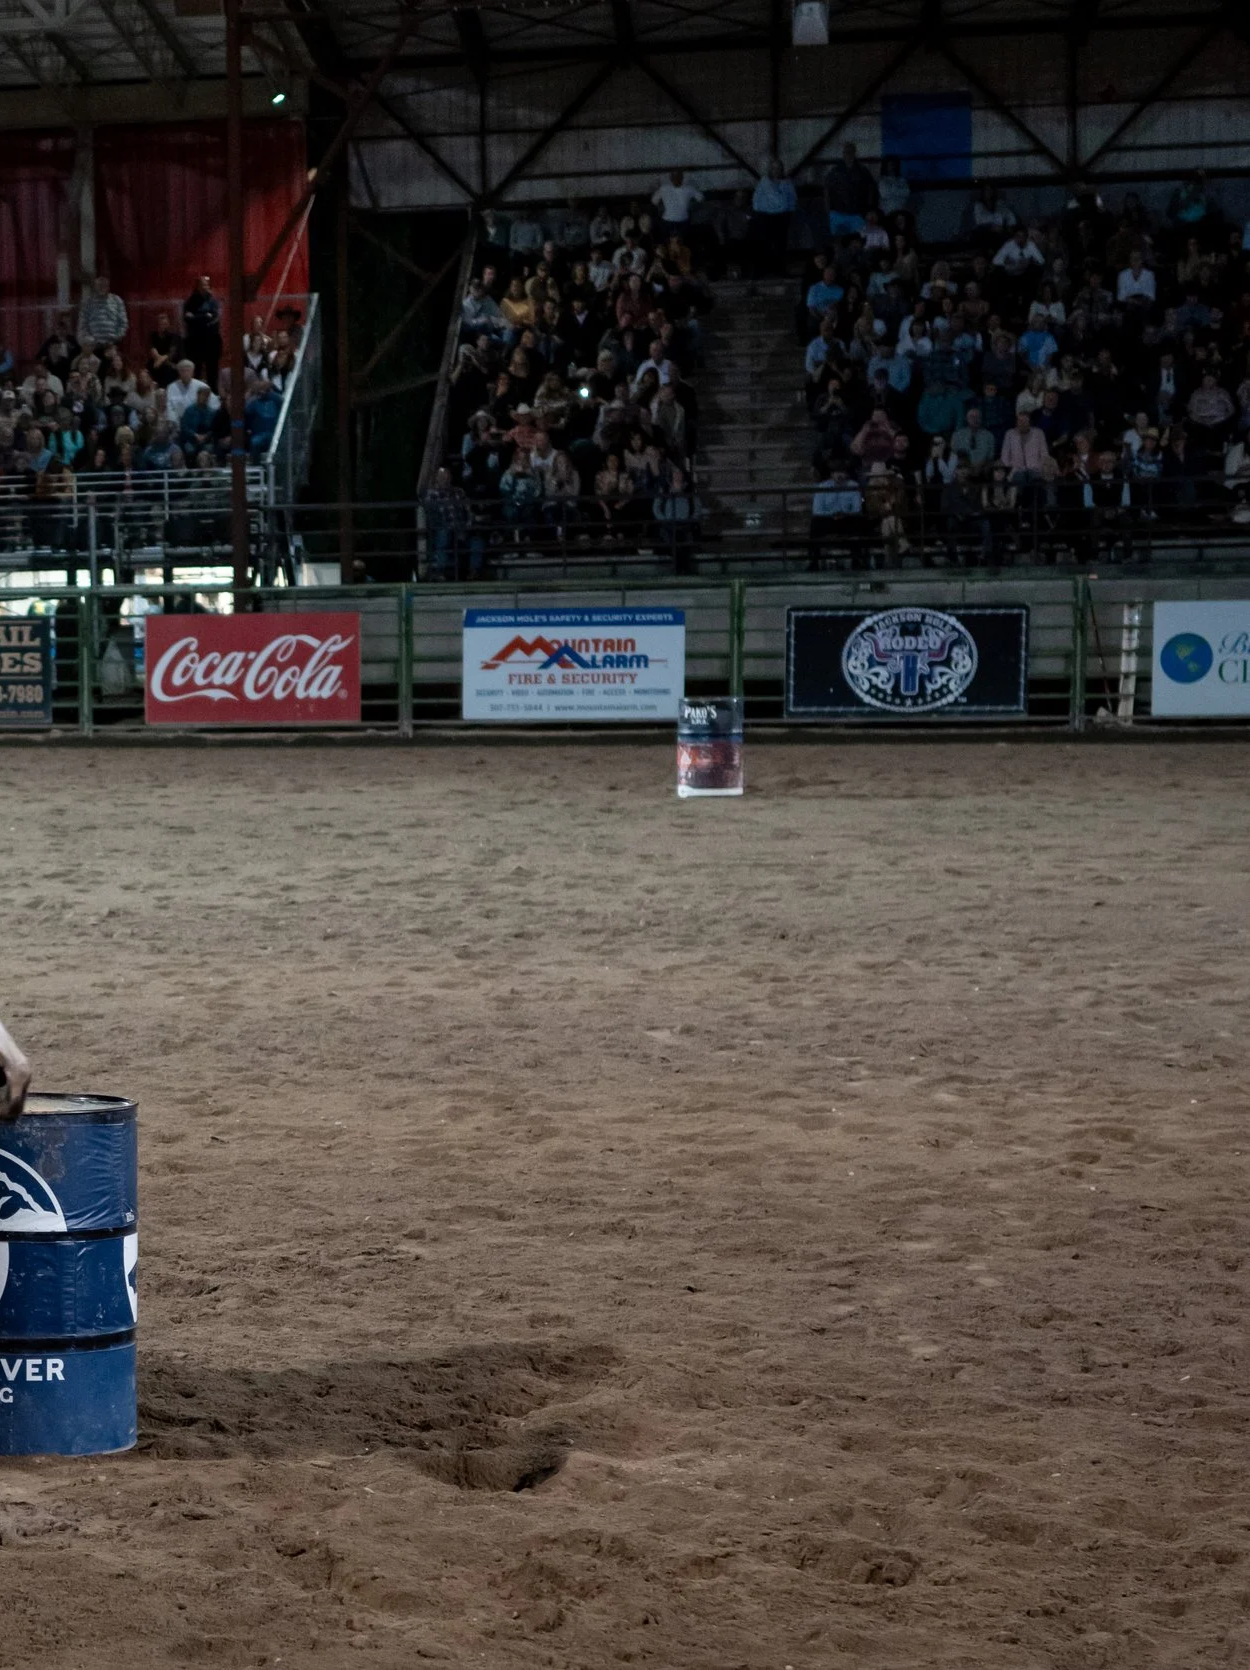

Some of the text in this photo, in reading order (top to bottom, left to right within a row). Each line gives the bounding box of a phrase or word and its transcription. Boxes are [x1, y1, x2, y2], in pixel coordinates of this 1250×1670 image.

[476, 615, 515, 623] JACKSON
[549, 614, 581, 622] SAFETY
[592, 614, 633, 622] SECURITY
[635, 613, 674, 621] EXPERTS
[877, 635, 942, 650] RODEO
[537, 643, 650, 669] ALARM
[151, 633, 355, 702] Coca-Cola
[508, 671, 638, 686] FIRE & SECURITY
